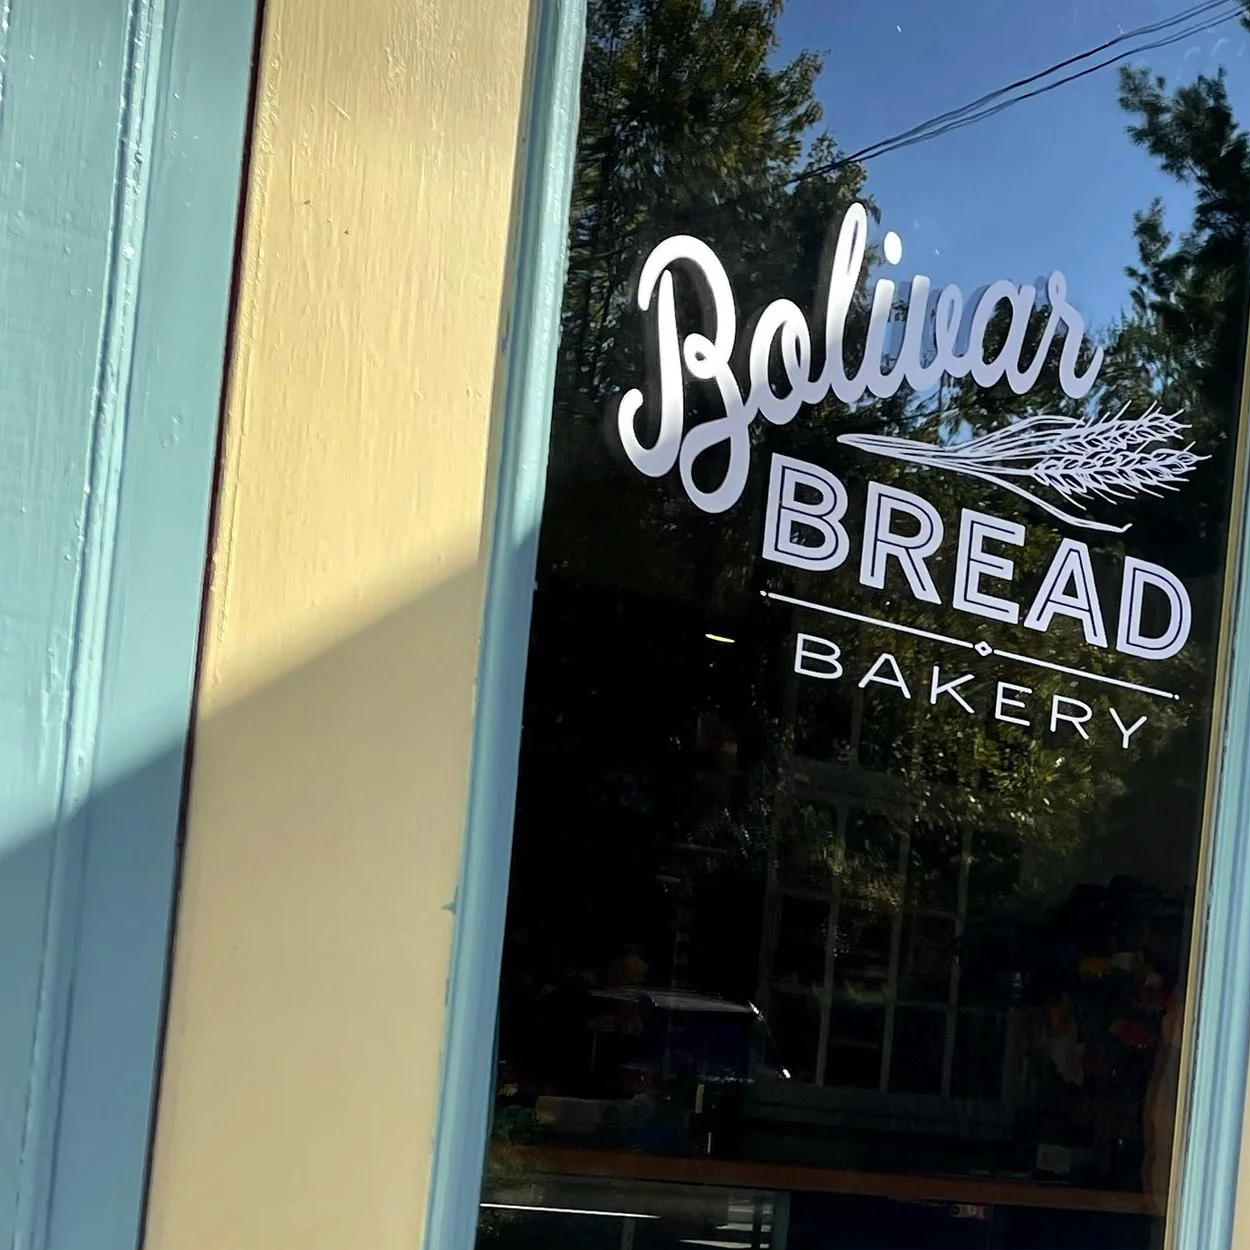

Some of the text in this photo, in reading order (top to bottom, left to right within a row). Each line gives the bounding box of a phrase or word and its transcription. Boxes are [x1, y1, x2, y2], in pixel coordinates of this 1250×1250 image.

[617, 202, 1104, 514] Bolivar
[762, 452, 1192, 660] BREAD
[794, 632, 1148, 749] BAKERY
